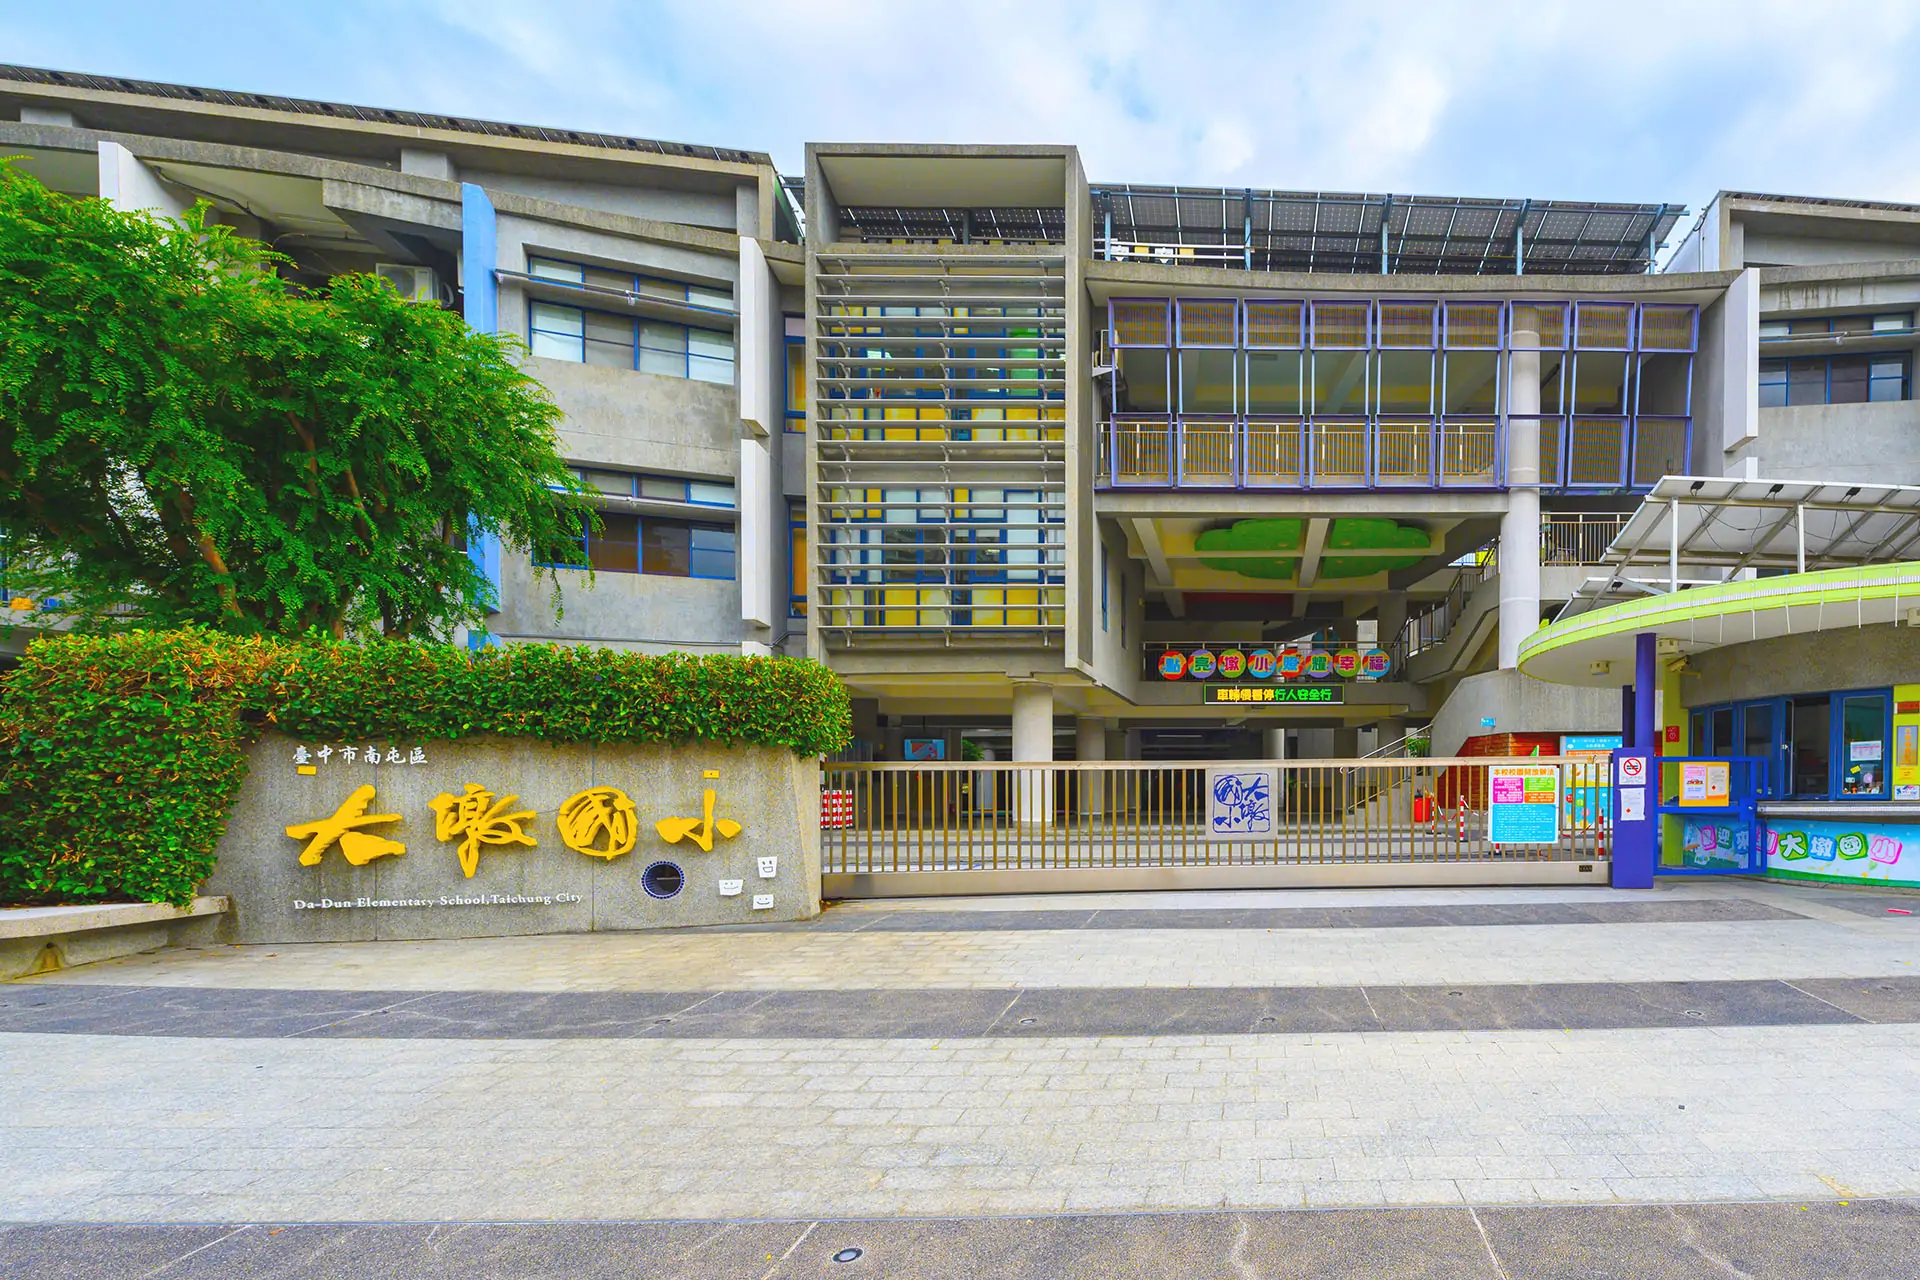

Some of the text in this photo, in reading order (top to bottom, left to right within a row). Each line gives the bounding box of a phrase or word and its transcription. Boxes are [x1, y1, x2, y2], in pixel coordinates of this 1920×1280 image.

[292, 744, 428, 764] 臺中市南屯區
[286, 783, 742, 878] 大墩國小
[294, 898, 351, 910] Da-Dun
[357, 897, 434, 909] Elementary
[556, 892, 584, 904] City
